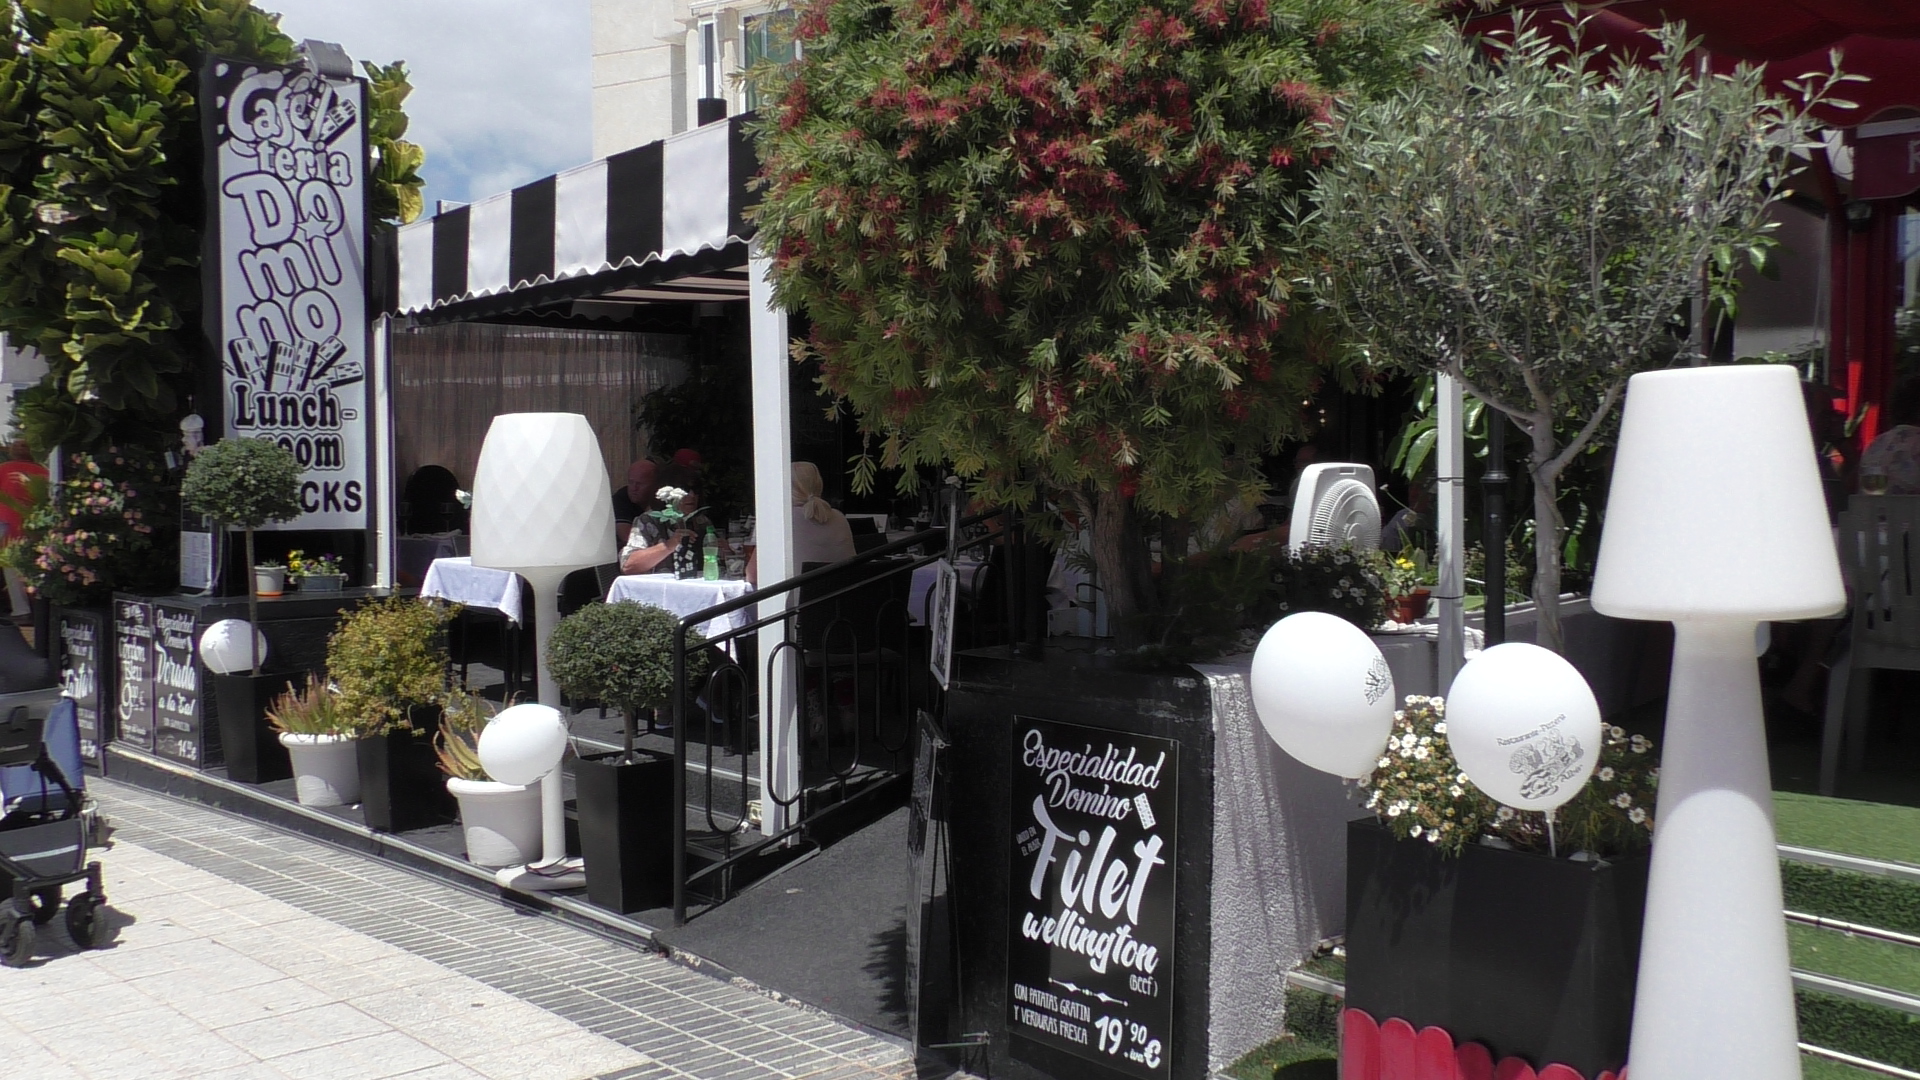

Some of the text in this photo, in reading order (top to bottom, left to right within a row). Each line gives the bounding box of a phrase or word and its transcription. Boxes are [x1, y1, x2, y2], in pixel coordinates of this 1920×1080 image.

[257, 139, 353, 187] teria
[222, 170, 345, 248] Do
[231, 380, 357, 431] Lunch-
[157, 609, 195, 634] Especialidad
[154, 640, 196, 691] Dorada
[158, 697, 165, 709] a
[166, 693, 176, 712] la
[1023, 728, 1166, 789] Especialidad
[1045, 769, 1133, 820] Domino
[1030, 794, 1166, 926] Filet
[1022, 908, 1160, 975] wellington
[1013, 1004, 1088, 1045] Y VERDURAS FRESCA
[1014, 983, 1091, 1023] CON PATATAS GRATIN
